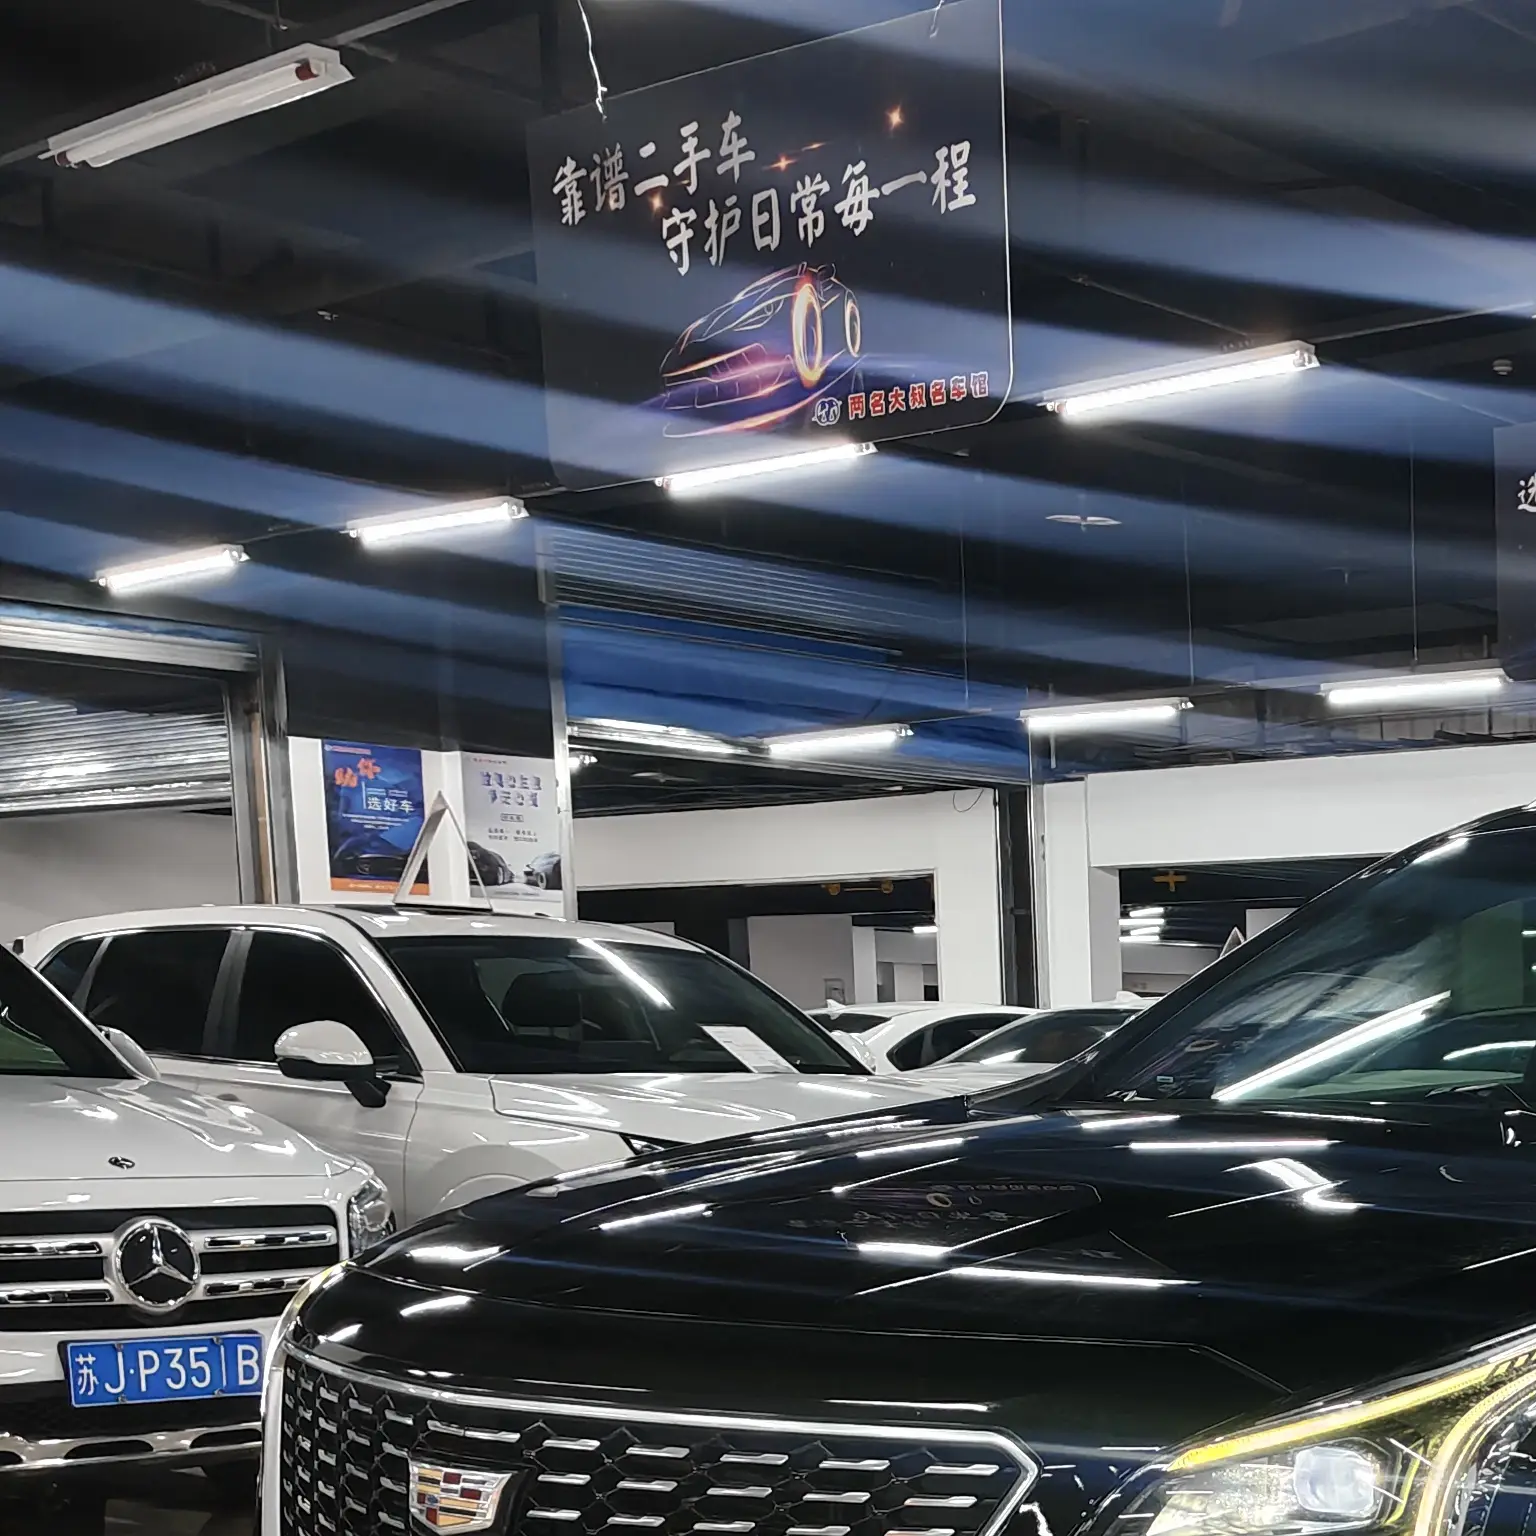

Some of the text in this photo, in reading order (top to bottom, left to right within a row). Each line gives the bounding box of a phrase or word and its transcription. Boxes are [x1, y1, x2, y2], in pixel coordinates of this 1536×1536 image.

[552, 110, 755, 227] 靠谱二手车
[662, 140, 978, 276] 守护日常每一程
[848, 372, 989, 420] 两名大叔名车馆
[367, 797, 415, 814] 选好车
